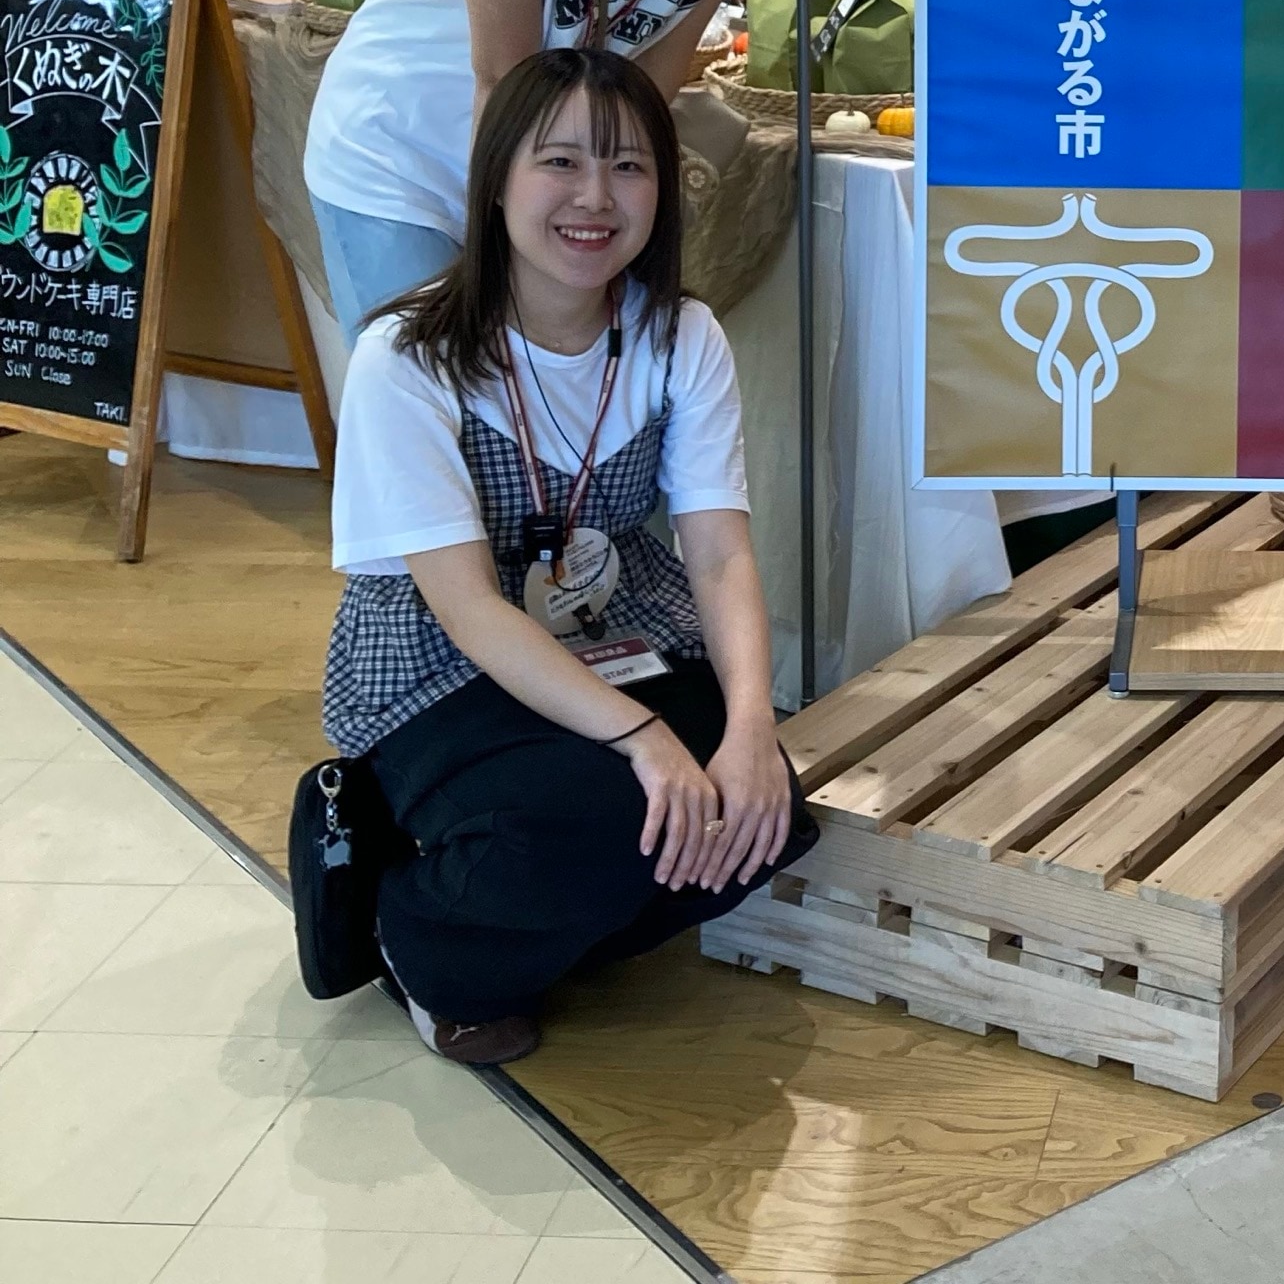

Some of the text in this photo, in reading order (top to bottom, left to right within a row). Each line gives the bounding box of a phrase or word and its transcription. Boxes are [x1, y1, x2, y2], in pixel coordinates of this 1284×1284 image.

[12, 39, 132, 106] くぬぎの木
[0, 266, 139, 319] ウンドケーキ専門店
[2, 336, 28, 355] SAT
[4, 359, 32, 379] SUN
[602, 666, 634, 680] STAFF
